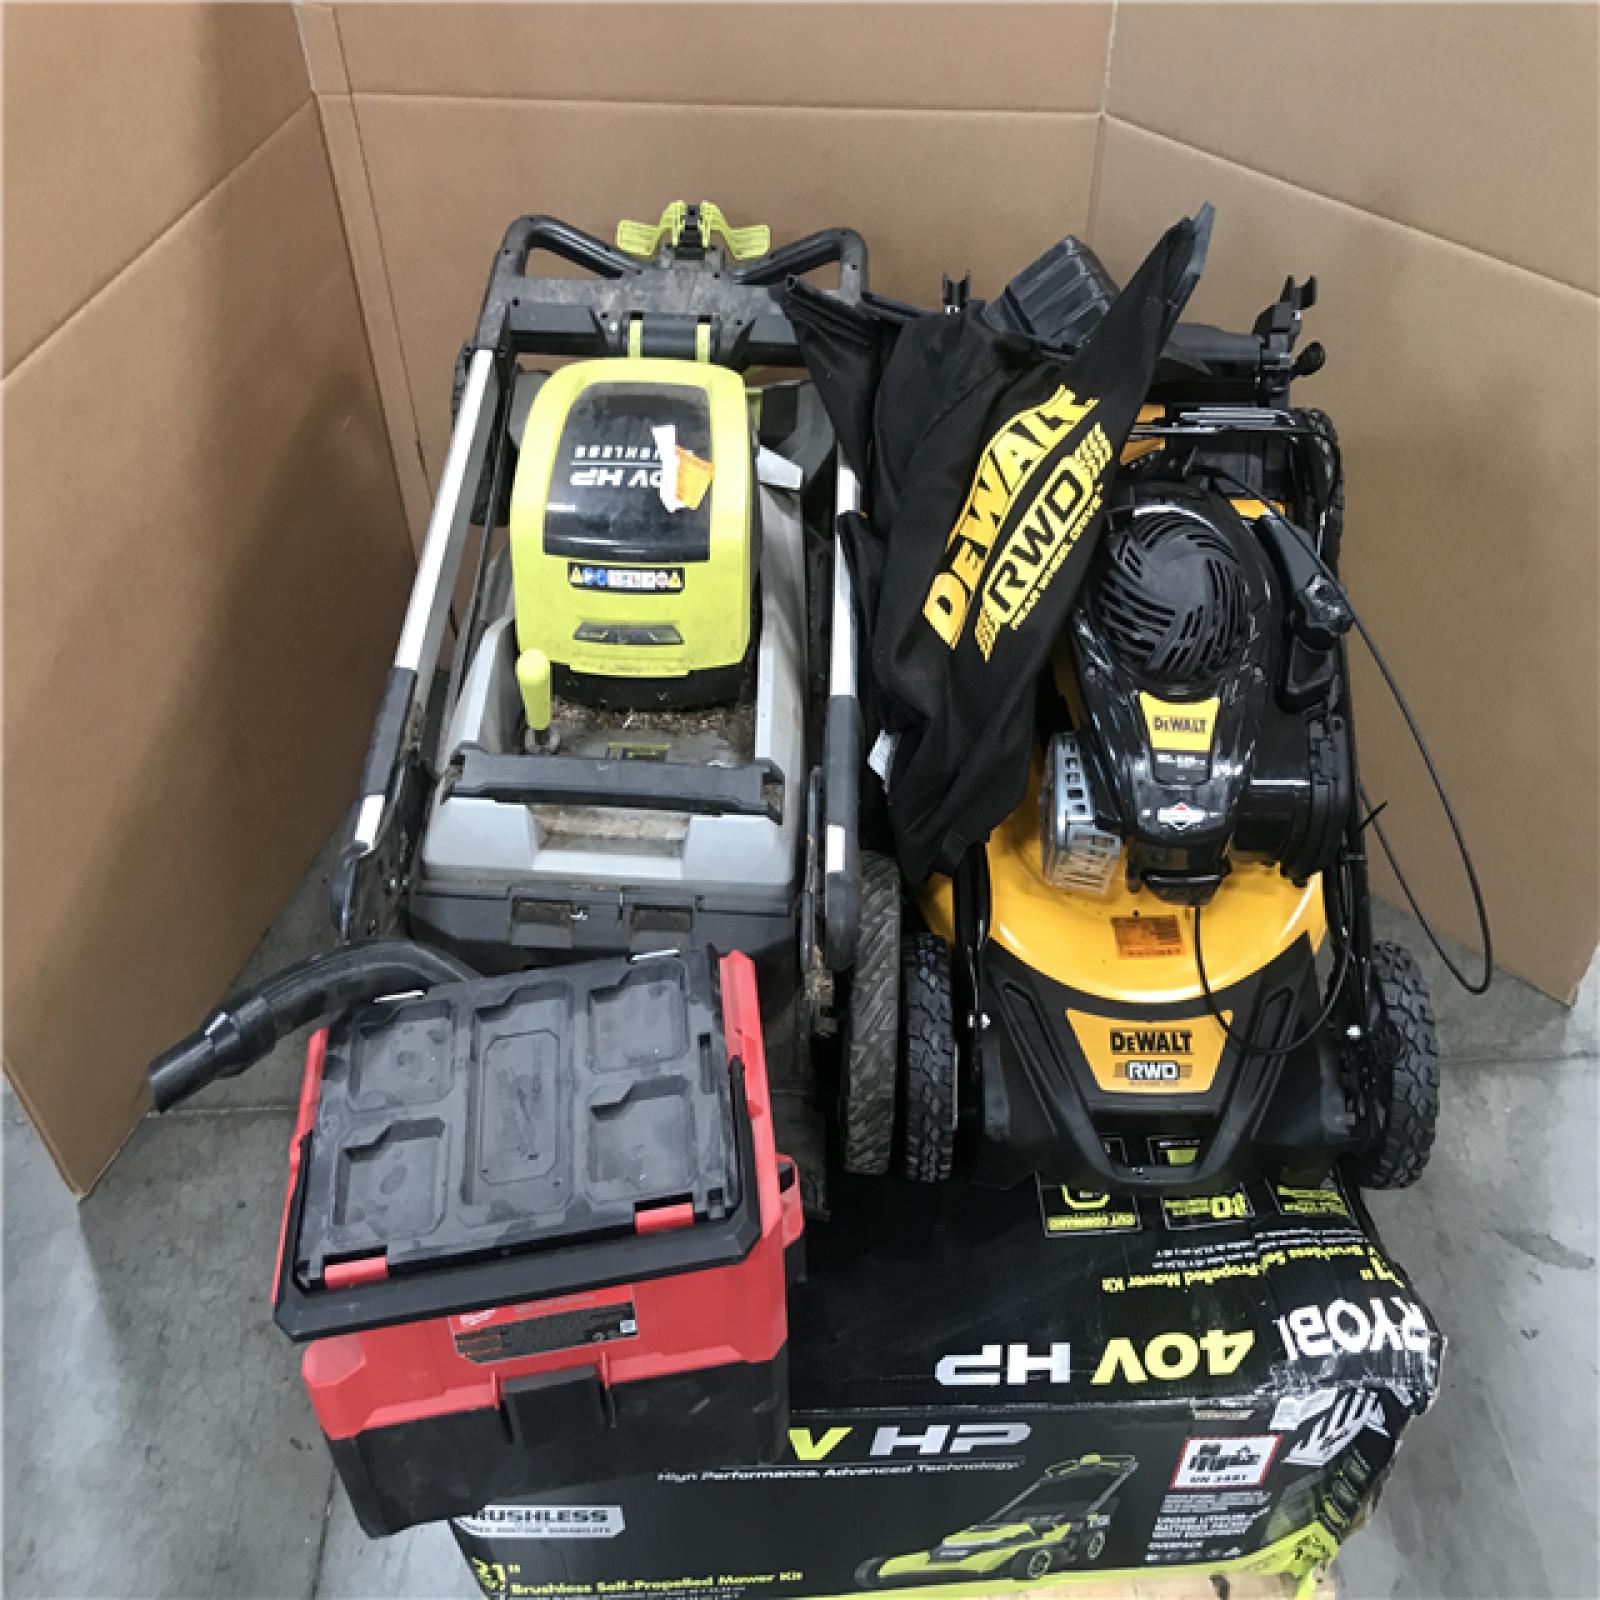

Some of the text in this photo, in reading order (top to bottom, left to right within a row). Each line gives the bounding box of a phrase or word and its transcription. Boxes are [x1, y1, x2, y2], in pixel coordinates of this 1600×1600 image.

[570, 469, 662, 488] 0V HP
[984, 463, 1088, 618] RWD
[1129, 1061, 1178, 1079] RWD
[1102, 1277, 1125, 1293] Kit
[1276, 1295, 1430, 1361] RYOBI
[935, 1330, 1256, 1386] 40V HP
[869, 1423, 1032, 1456] HP
[477, 1508, 608, 1523] USHLESS
